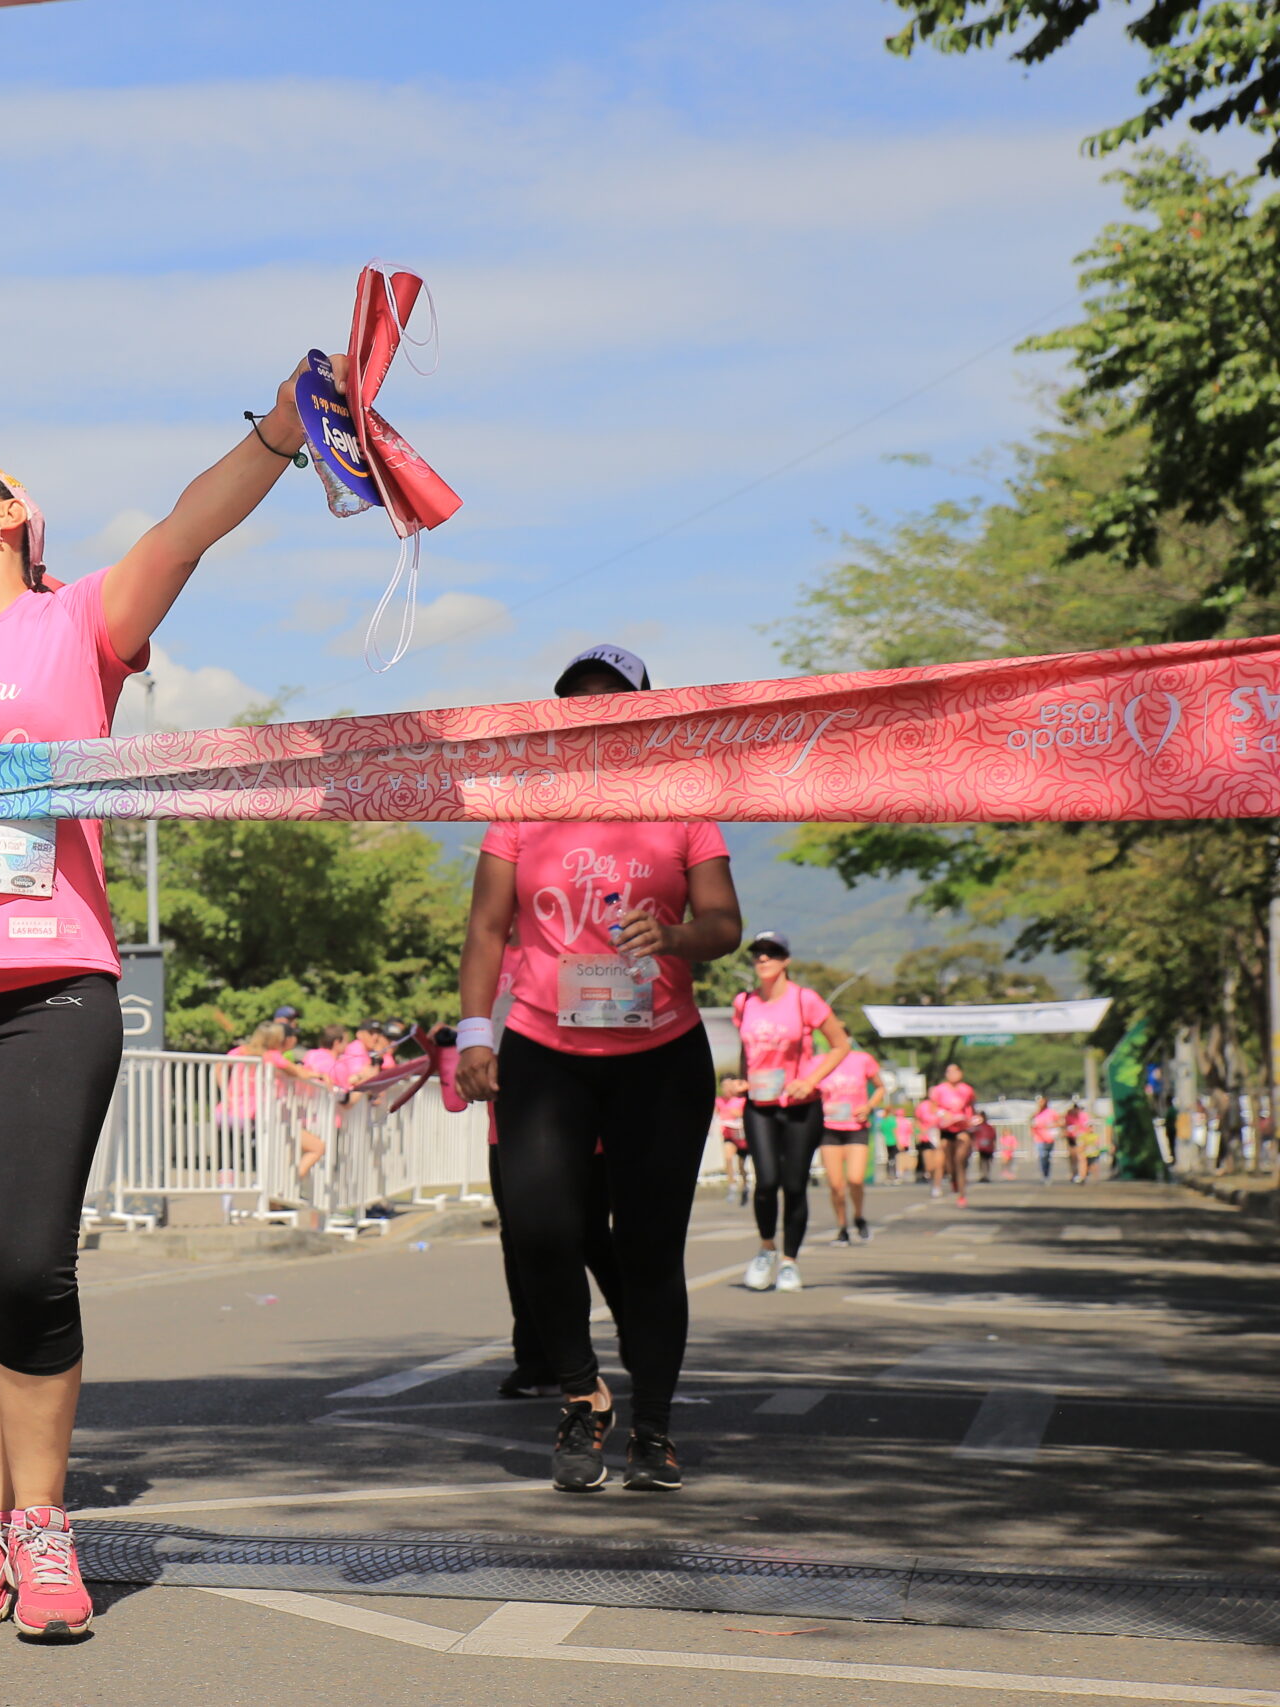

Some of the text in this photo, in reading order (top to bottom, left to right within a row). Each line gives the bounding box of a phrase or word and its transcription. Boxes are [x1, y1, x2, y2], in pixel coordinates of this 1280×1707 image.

[1039, 700, 1115, 728] rosa
[645, 708, 859, 778] Leonisa
[1006, 725, 1114, 761] modo
[323, 769, 557, 793] CARRERA DE
[562, 848, 653, 883] Por tu
